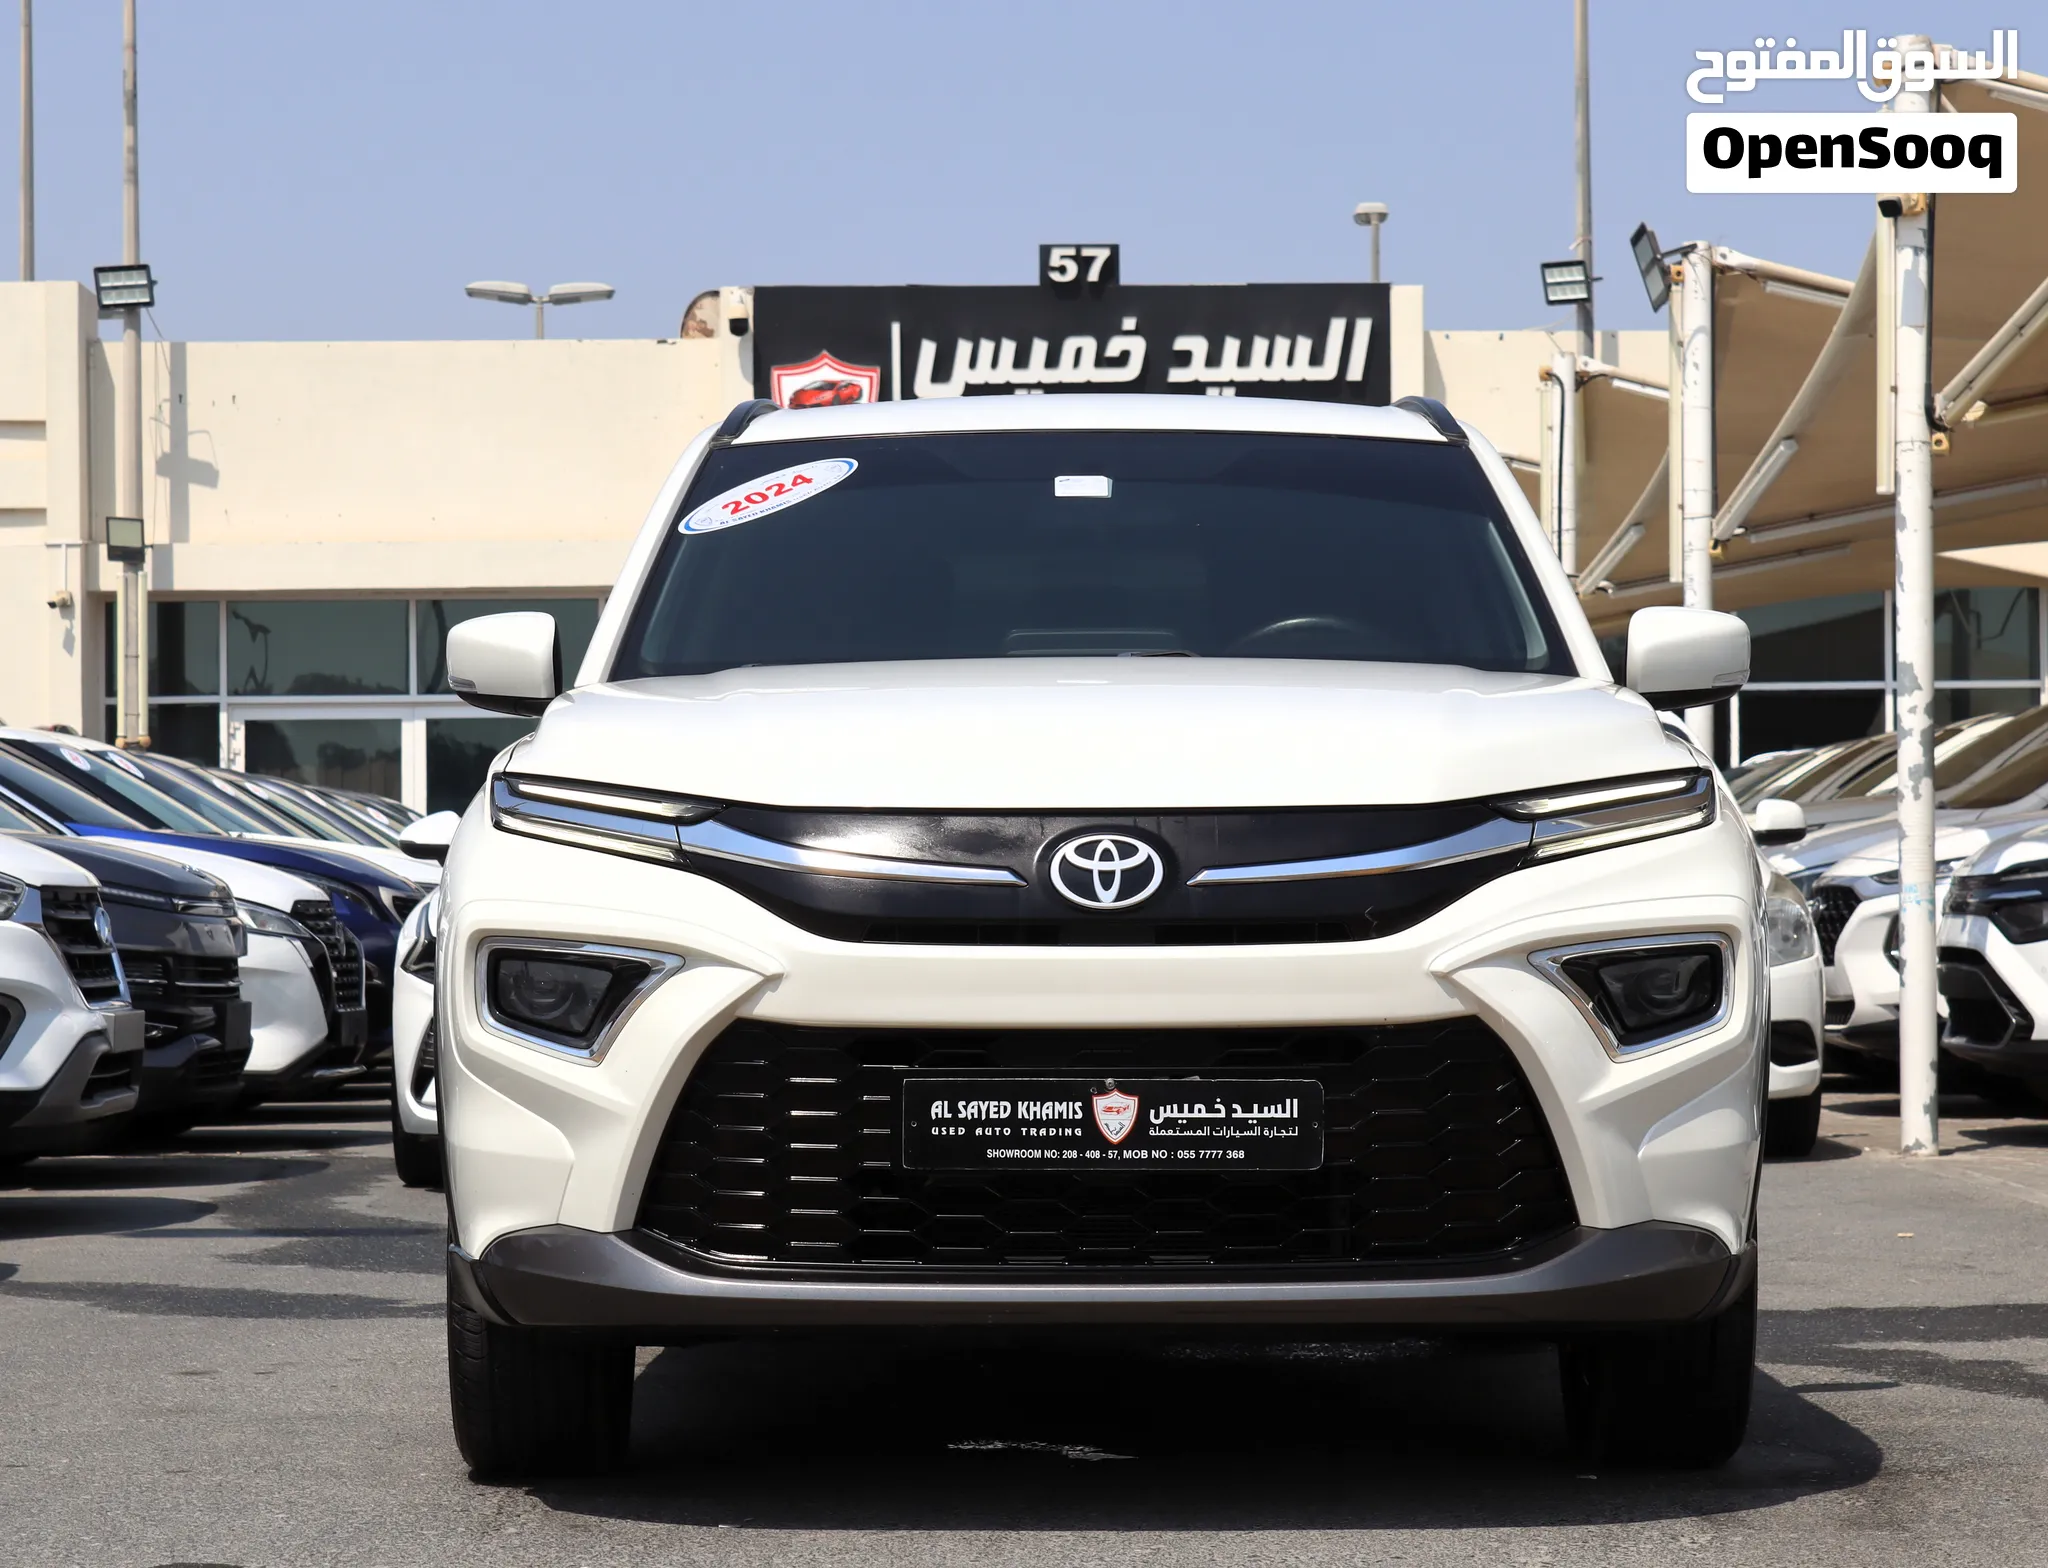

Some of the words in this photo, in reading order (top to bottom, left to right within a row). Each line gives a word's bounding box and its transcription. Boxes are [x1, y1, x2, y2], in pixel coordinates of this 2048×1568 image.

[1048, 247, 1113, 283] 57
[913, 316, 1148, 398] خميس
[1167, 317, 1374, 396] السيد
[721, 473, 814, 516] 2024
[931, 1100, 953, 1120] AL
[957, 1100, 1012, 1121] SAYED
[1017, 1100, 1083, 1122] KHAMIS
[1149, 1097, 1226, 1125] خميس
[1231, 1098, 1299, 1125] السيد
[931, 1127, 966, 1137] USED
[975, 1127, 1011, 1137] AUTO
[1020, 1127, 1082, 1137] TRADING
[1148, 1126, 1211, 1137] المستعملة
[1212, 1126, 1261, 1139] السيارات
[1263, 1126, 1299, 1139] لتجارة
[986, 1149, 1042, 1159] SHOWROOM
[1044, 1149, 1060, 1159] NO:
[1062, 1149, 1078, 1159] 208
[1084, 1149, 1101, 1159] 408
[1107, 1149, 1121, 1161] 57,
[1122, 1149, 1149, 1159] MOB
[1151, 1149, 1168, 1159] NO
[1177, 1149, 1196, 1159] 055
[1198, 1149, 1224, 1159] 7777
[1226, 1149, 1245, 1159] 368
